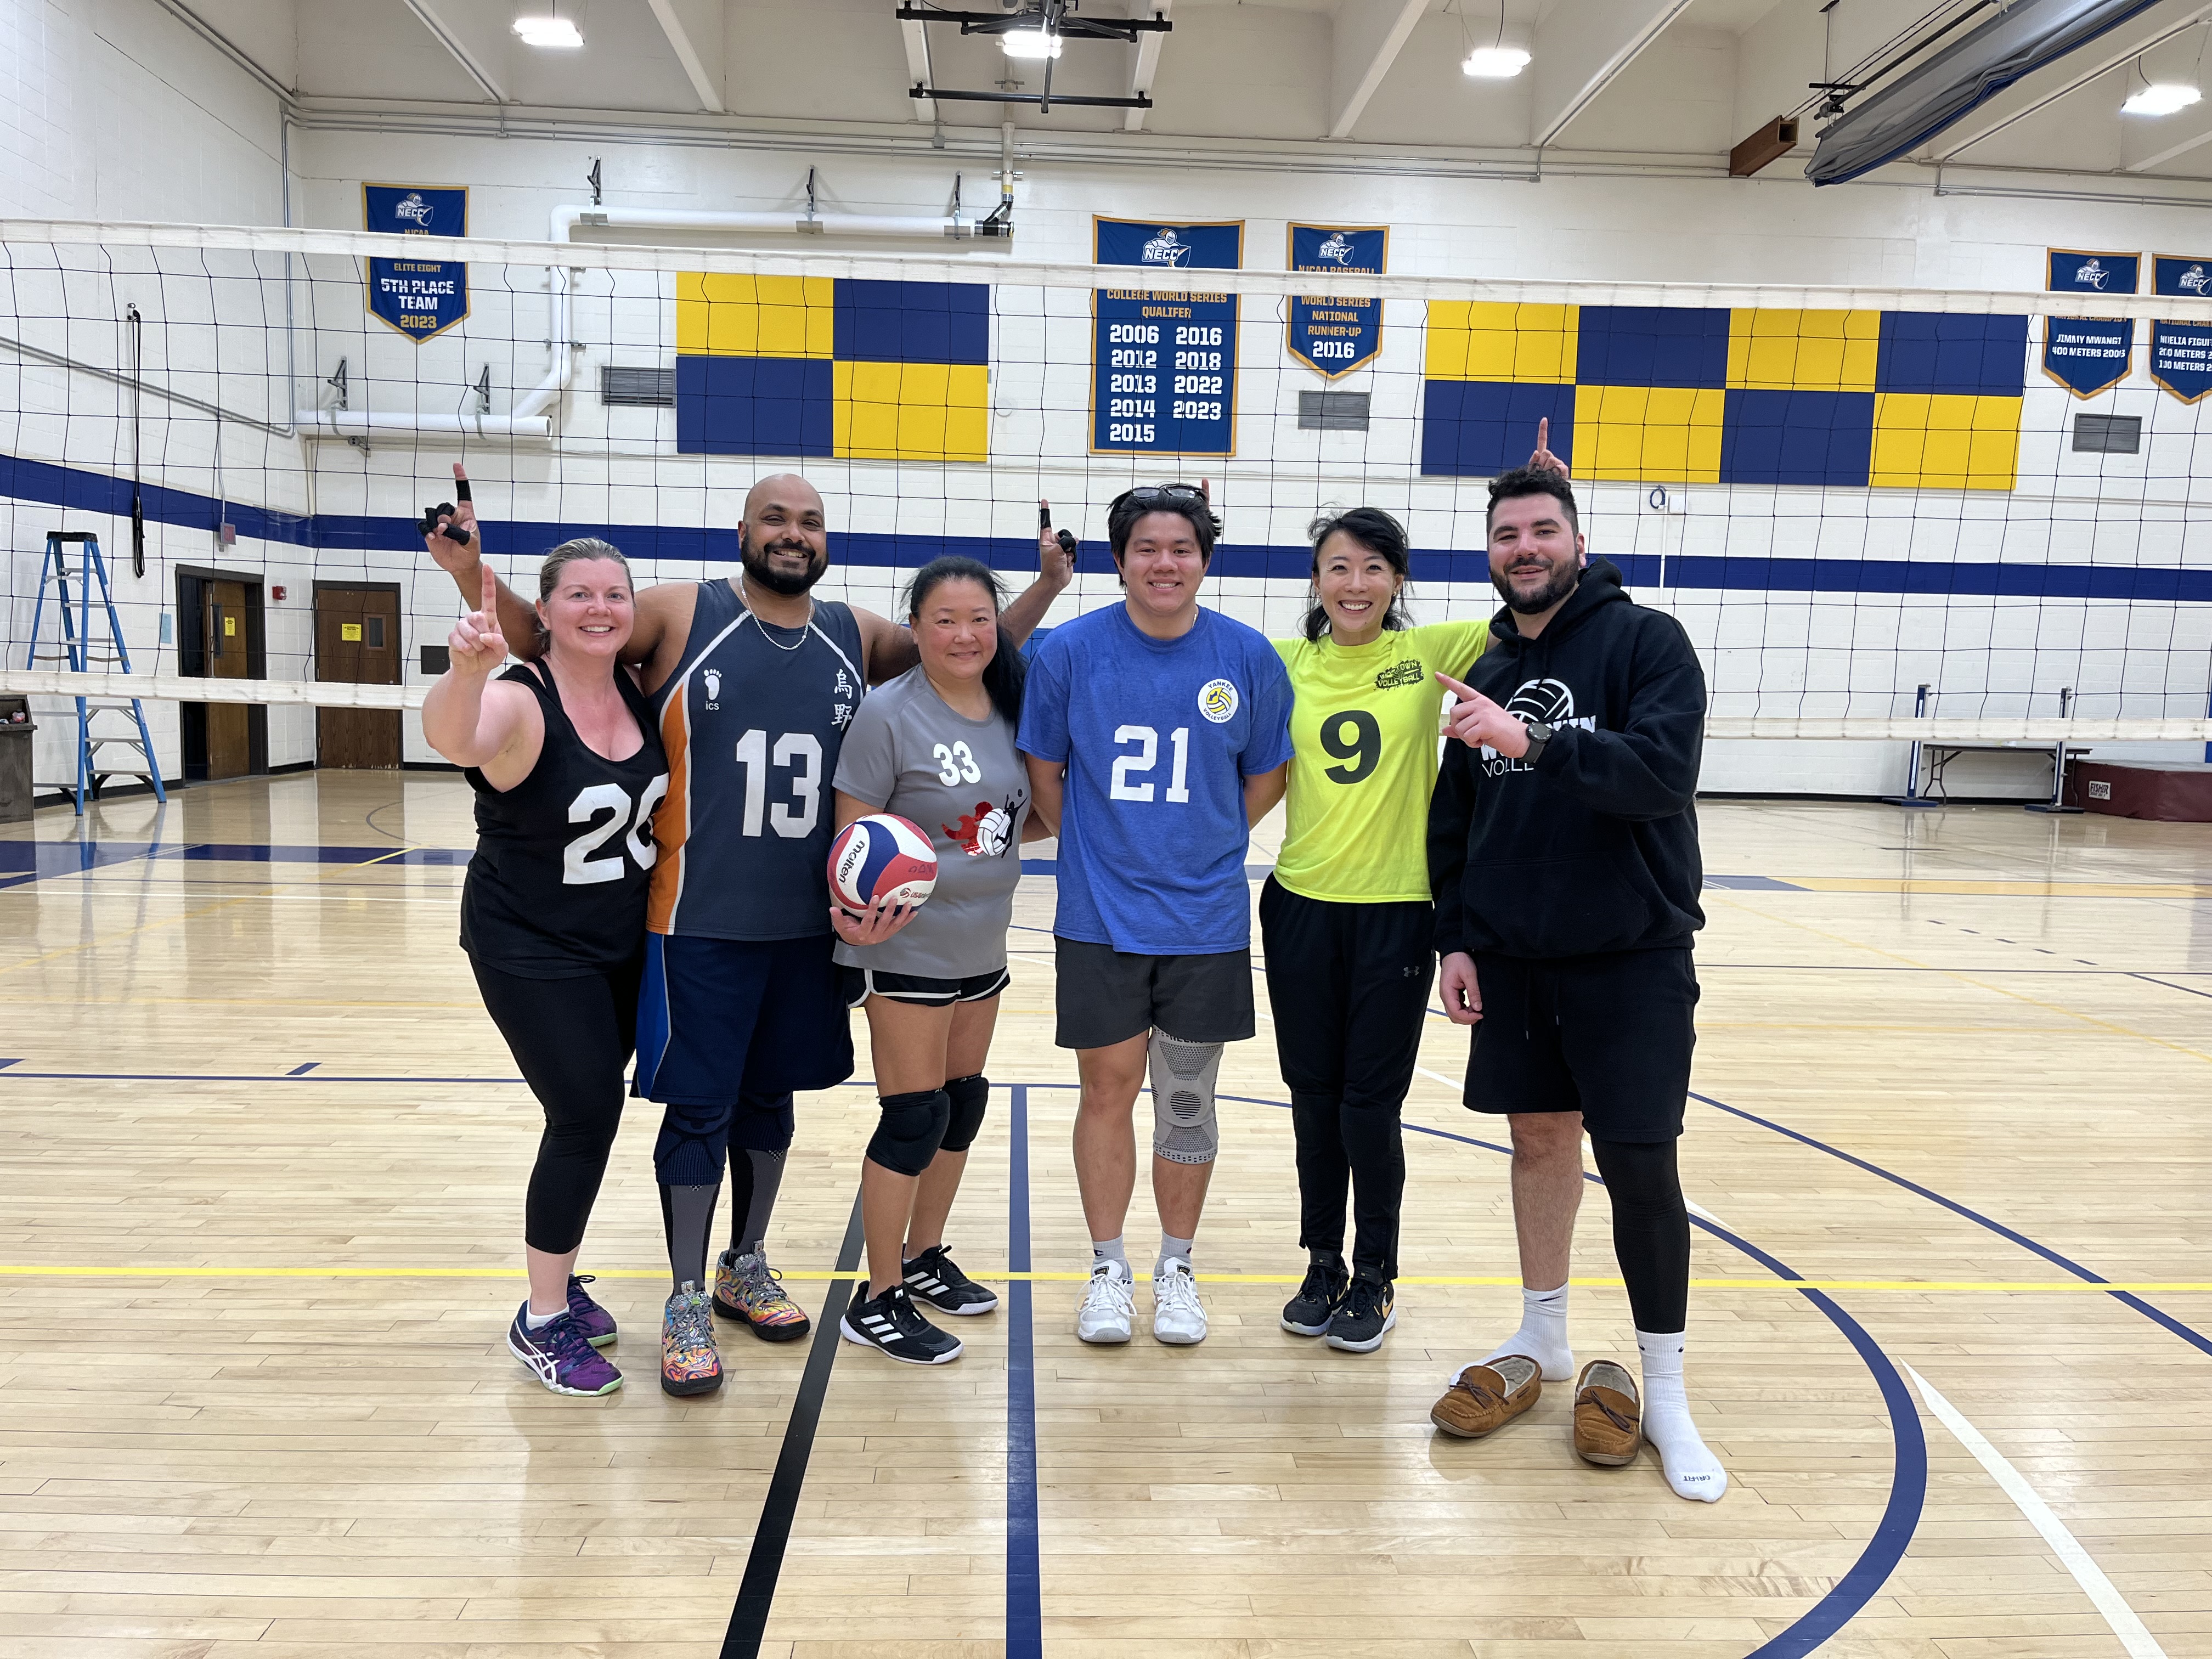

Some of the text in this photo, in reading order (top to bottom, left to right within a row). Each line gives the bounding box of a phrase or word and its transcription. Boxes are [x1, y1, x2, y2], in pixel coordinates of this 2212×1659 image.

[397, 208, 424, 217] NECC
[1144, 248, 1179, 261] NECC
[1320, 247, 1345, 257] NECC
[394, 263, 441, 273] ELITE EIGHT
[2077, 272, 2100, 281] NECC
[2180, 279, 2204, 287] NECC
[381, 278, 454, 294] 5TH PLACE
[398, 296, 438, 309] TEAM
[1107, 290, 1227, 303] COLLEGE WORLD SERIES
[1301, 296, 1371, 307] WORLD SERIES
[1142, 306, 1191, 318] QUALIFER
[1312, 311, 1358, 321] NATIONAL
[400, 315, 437, 328] 2023
[1110, 324, 1222, 346] 2006 2016
[1308, 326, 1362, 337] RUNNER-UP
[2056, 334, 2121, 345] JIMMY MWANGI
[1313, 341, 1355, 359] 2016
[2052, 346, 2068, 356] 400
[2069, 347, 2101, 357] METERS
[2174, 349, 2206, 359] METERS
[1111, 349, 1221, 370] 2012 2018
[2173, 361, 2205, 371] METERS
[1110, 374, 1222, 394] 2013 2022
[1110, 399, 1222, 420] 2014 2023
[1110, 424, 1155, 443] 2015
[1207, 681, 1233, 692] YANKEE
[1378, 673, 1420, 687] VOLLEYBALL
[706, 701, 719, 710] ics
[1203, 708, 1232, 720] VOLLEYBALL
[1320, 710, 1381, 785] 9
[933, 740, 981, 787] 33
[1110, 724, 1189, 803] 21
[736, 729, 822, 838] 13
[838, 840, 865, 883] molten
